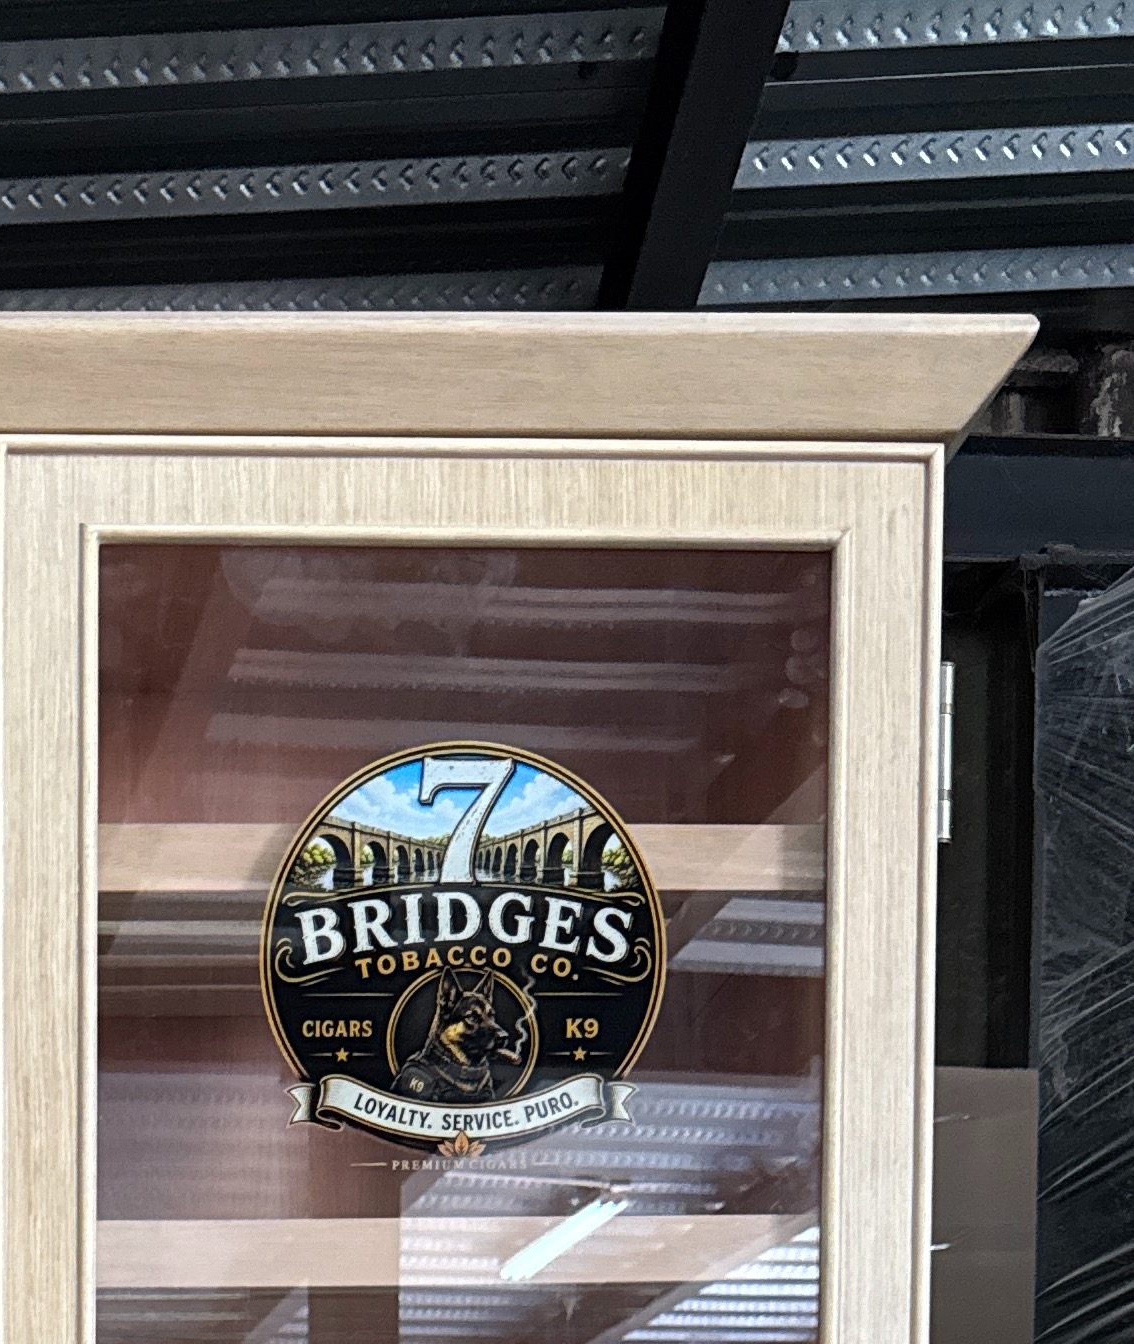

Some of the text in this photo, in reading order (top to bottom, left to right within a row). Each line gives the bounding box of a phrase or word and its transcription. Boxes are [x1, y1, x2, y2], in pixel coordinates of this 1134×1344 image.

[419, 756, 517, 884] 7
[294, 891, 635, 965] BRIDGES
[355, 945, 580, 981] TOBACCO CO.
[302, 1019, 373, 1038] CIGARS
[566, 1018, 600, 1039] K9
[409, 1077, 425, 1093] K9
[353, 1092, 580, 1131] LOYALTY. SERVICE. PURO.
[391, 1159, 527, 1171] PREMIUM CIGARS
